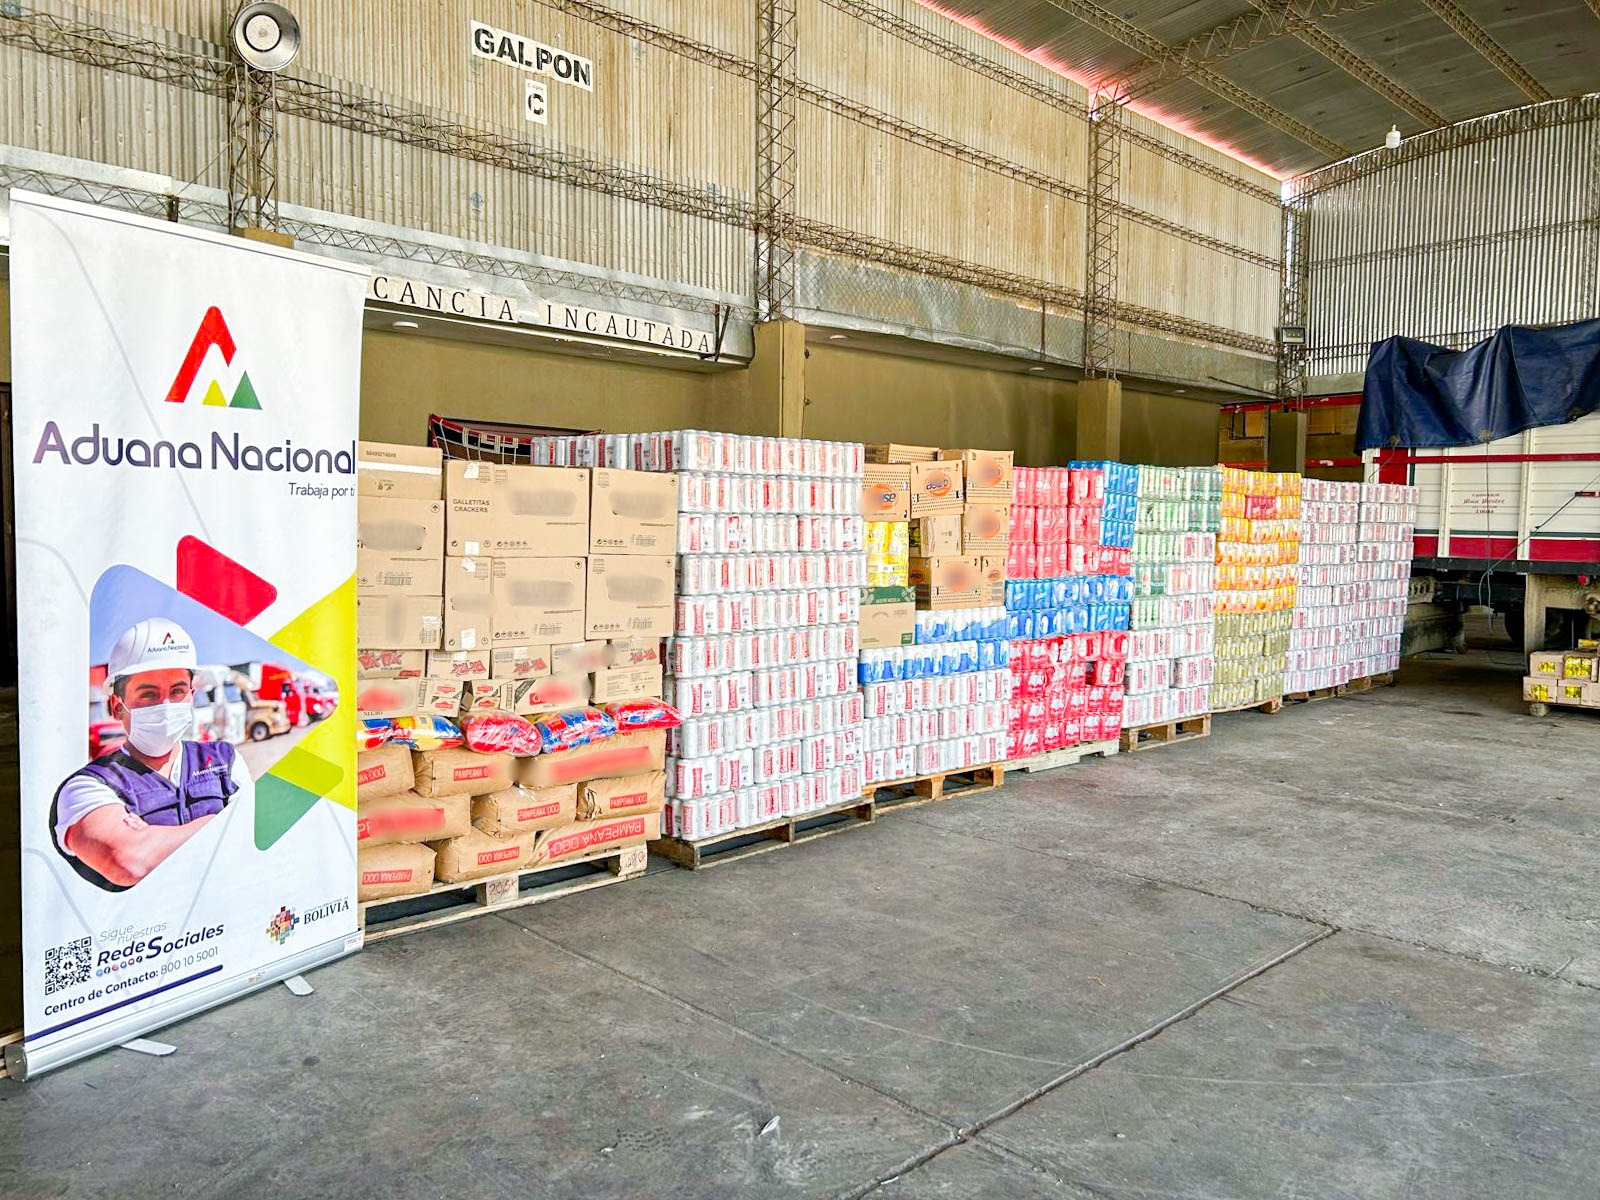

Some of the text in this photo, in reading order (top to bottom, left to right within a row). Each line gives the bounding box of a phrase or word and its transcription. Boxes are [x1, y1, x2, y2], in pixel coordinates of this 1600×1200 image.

[474, 28, 591, 86] GALPON
[528, 93, 544, 116] C
[547, 304, 710, 353] INCAUTADA
[32, 421, 356, 475] Aduana Nacional
[288, 482, 329, 500] Trabaja
[331, 487, 349, 500] por
[453, 498, 490, 506] GALLETITAS
[455, 767, 483, 779] PAMPEANA
[611, 797, 634, 808] PAMPEANA
[519, 808, 547, 821] PAMPEANA
[581, 820, 642, 842] PAMPEANA
[494, 848, 519, 861] PAMPEANA
[380, 870, 411, 882] PAMPEANA
[303, 900, 349, 925] BOLIVIA
[99, 924, 134, 943] Sigue
[117, 922, 168, 945] nuestras
[44, 946, 219, 1016] Centro de Contacto: 800 10 5001
